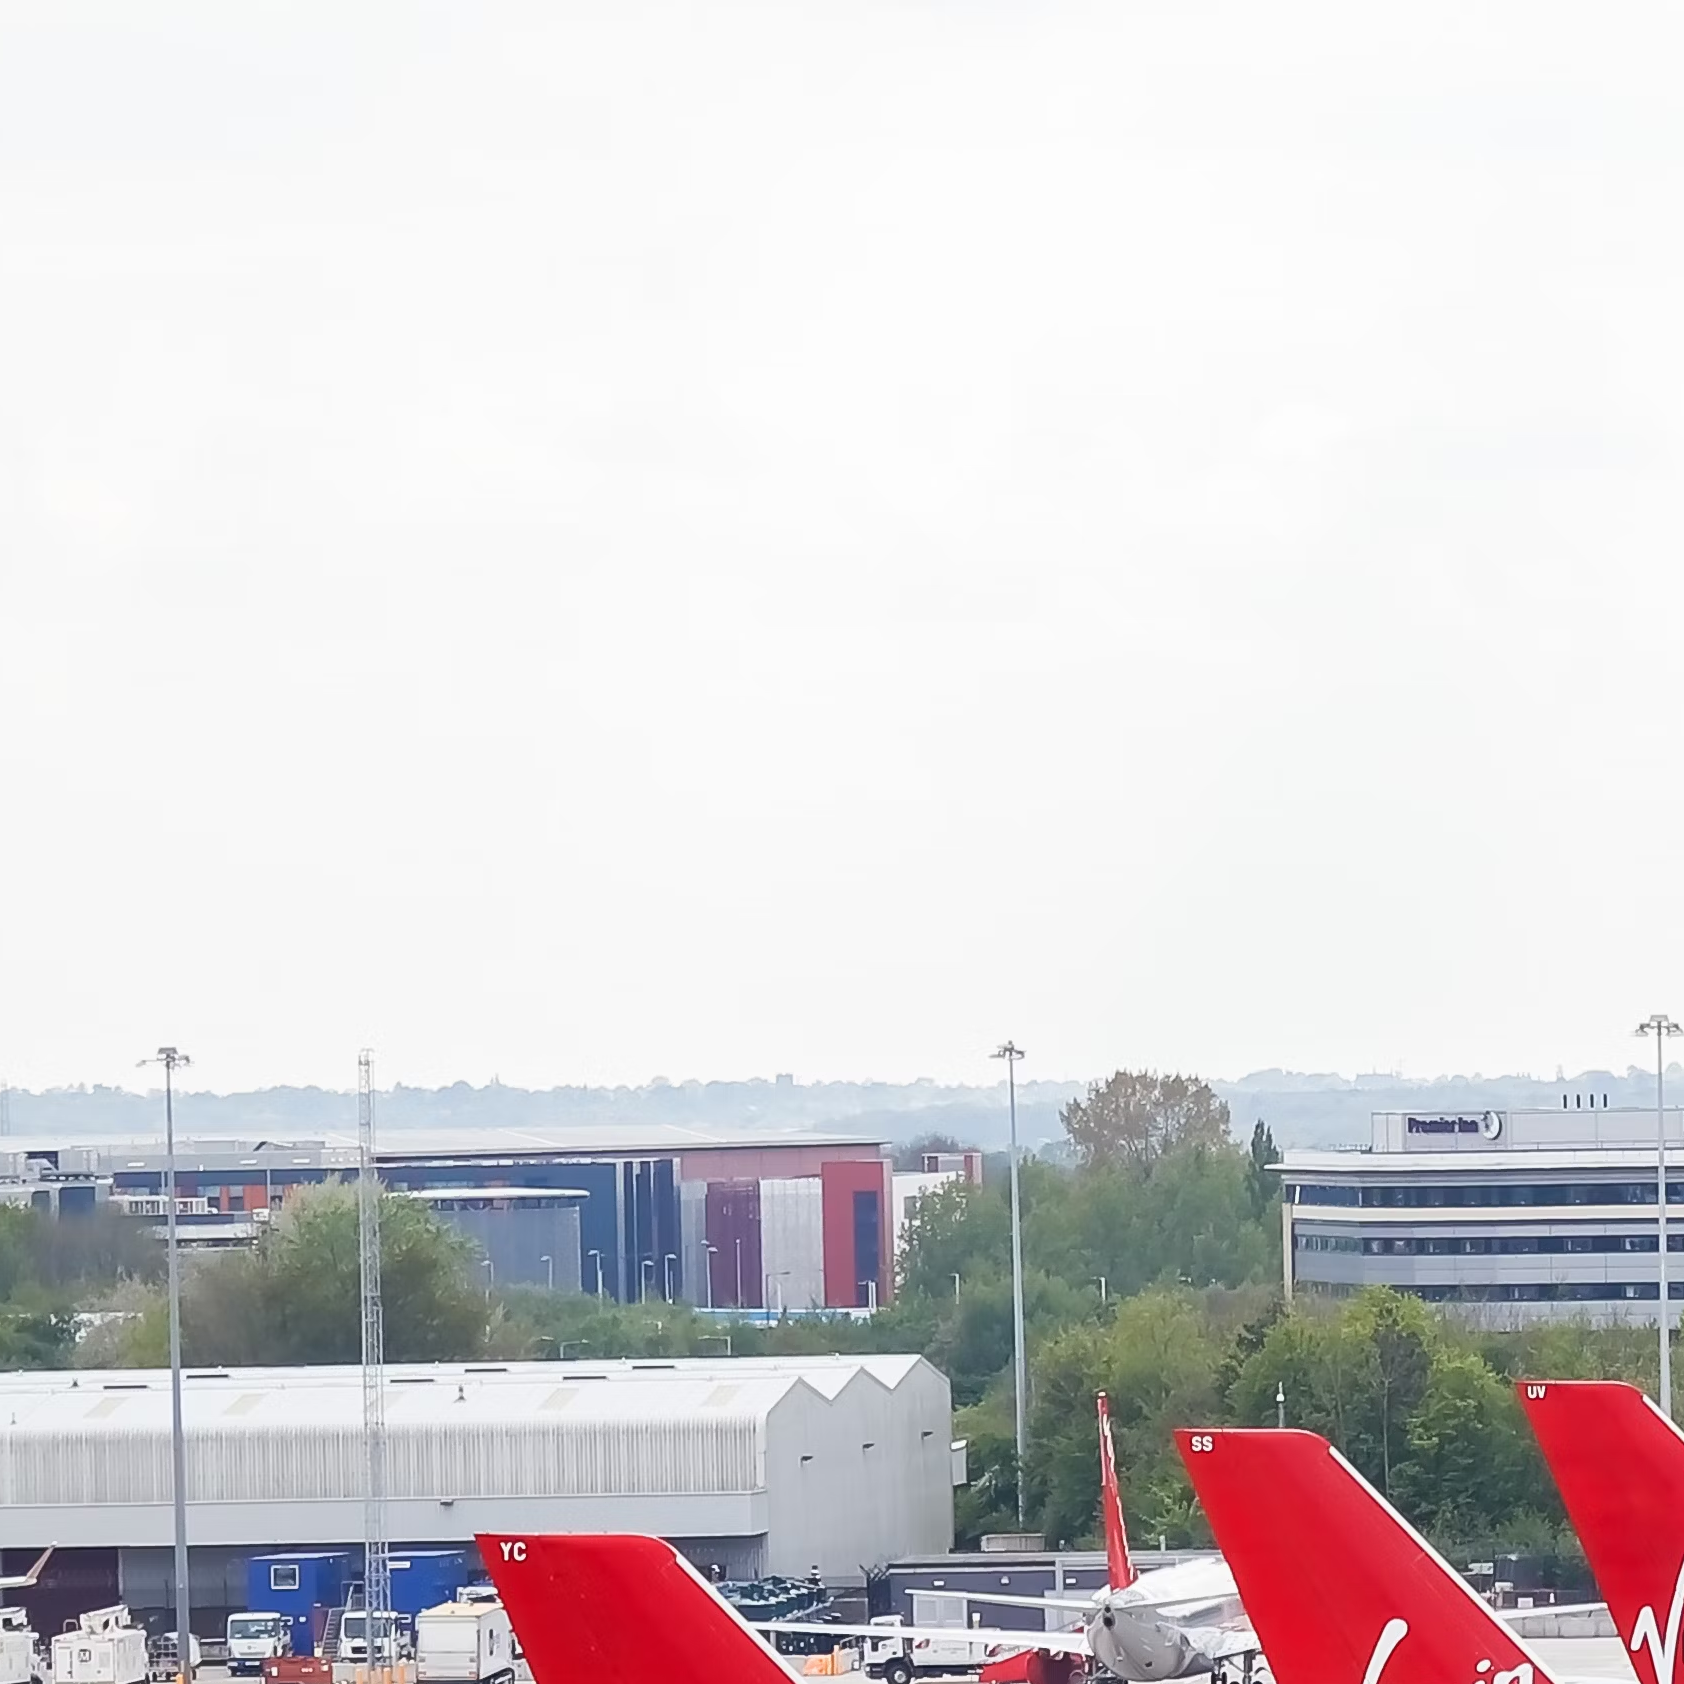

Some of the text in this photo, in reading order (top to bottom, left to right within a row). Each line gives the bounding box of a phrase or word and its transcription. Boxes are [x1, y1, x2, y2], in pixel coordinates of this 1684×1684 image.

[1527, 1384, 1546, 1398] UV
[1191, 1436, 1214, 1452] SS
[500, 1541, 527, 1560] YC
